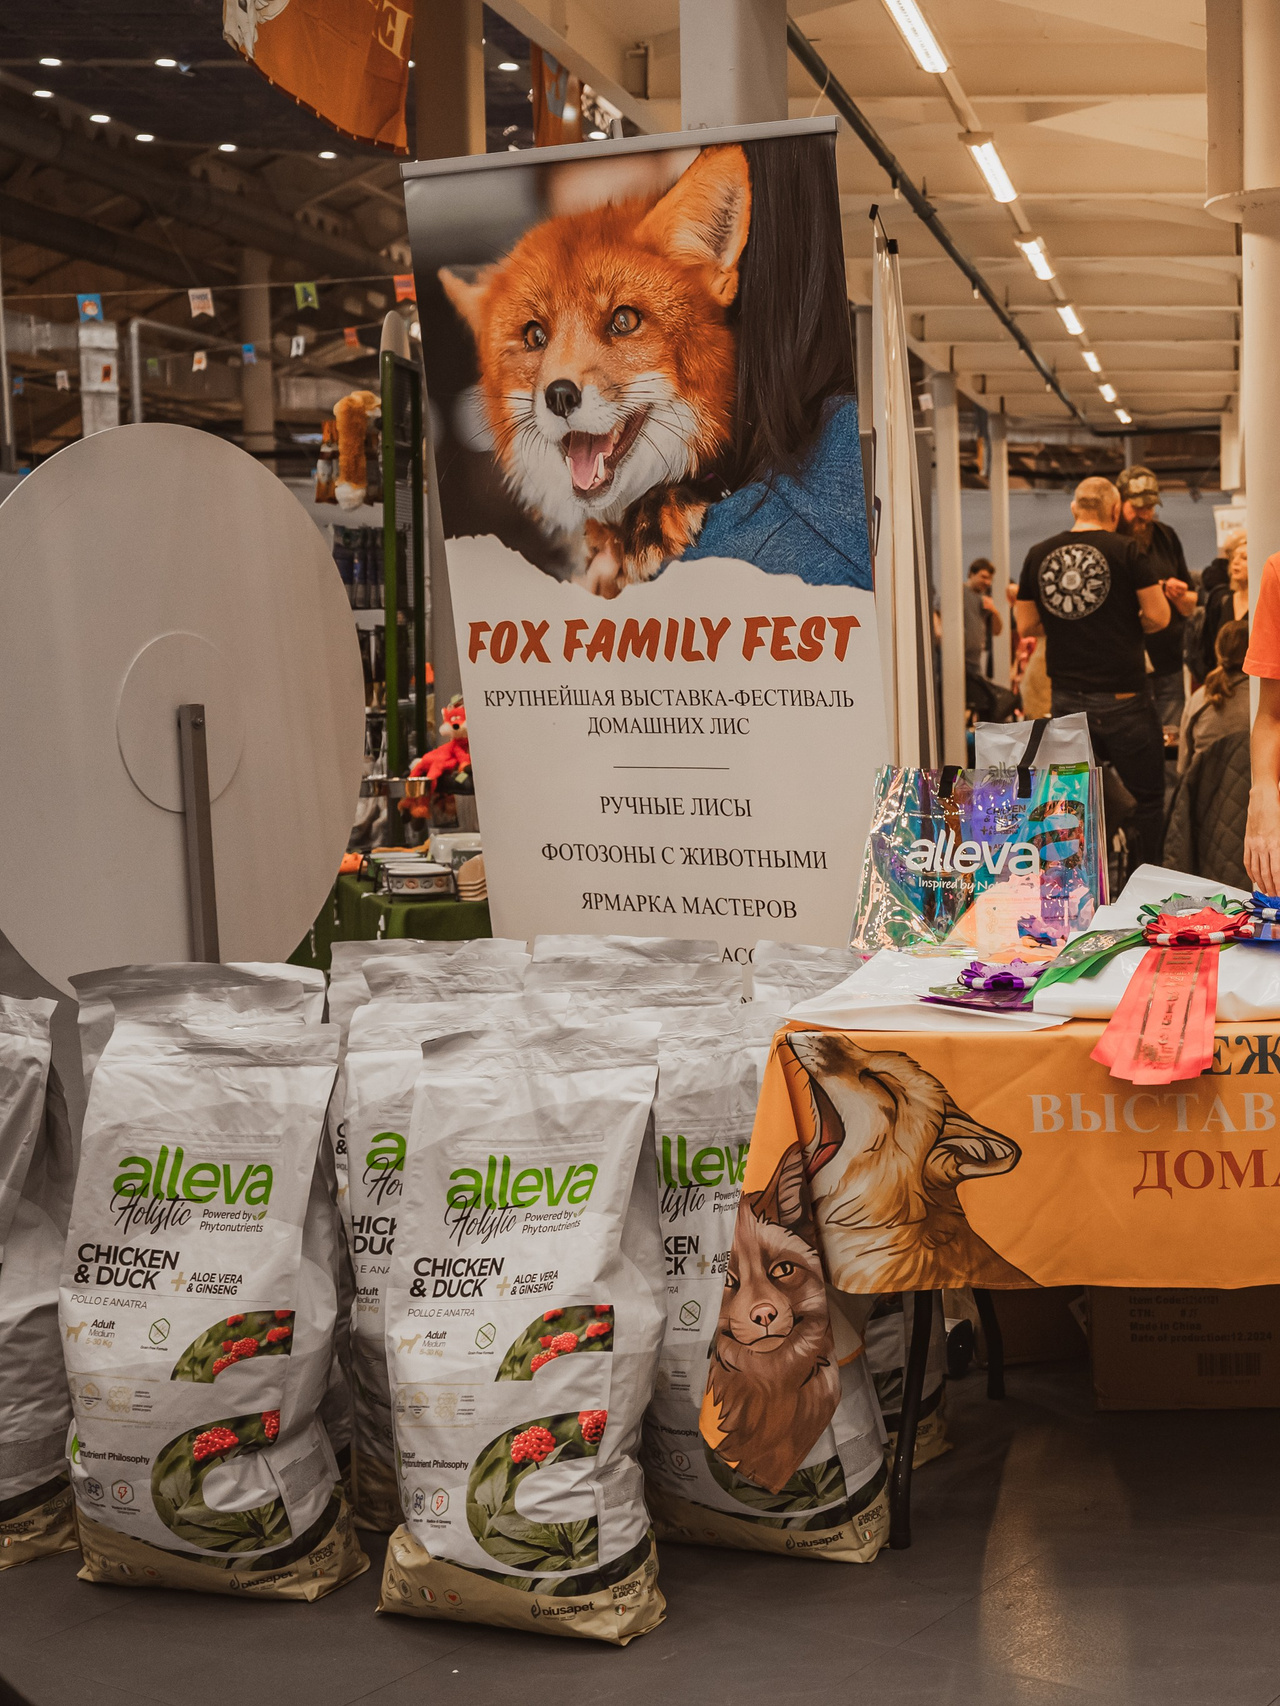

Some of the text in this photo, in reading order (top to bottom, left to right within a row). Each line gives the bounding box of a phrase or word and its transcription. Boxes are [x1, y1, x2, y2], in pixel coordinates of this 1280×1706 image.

[467, 615, 862, 665] FOX FAMILY FEST
[483, 684, 855, 708] КРУПНЕЙШАЯ ВЫСТАВКА-ФЕСТИВАЛЬ
[587, 716, 751, 737] ДОМАШНИХ ЛИС
[599, 796, 752, 818] РУЧНЫЕ ЛИСЫ
[541, 842, 829, 870] ФОТОЗОНЫ С ЖИВОТНЫМИ
[905, 829, 1040, 876] alleva
[918, 877, 958, 891] Inspired
[960, 878, 976, 891] by
[581, 892, 797, 919] ЯРМАРКА МАСТЕРОВ
[656, 1135, 750, 1188] llev
[112, 1144, 274, 1206] alleva
[445, 1154, 600, 1211] alleva
[109, 1182, 203, 1235] Holistic
[660, 1180, 713, 1223] listic
[202, 1208, 253, 1223] Powered by
[444, 1193, 526, 1247] Holistic
[523, 1210, 573, 1222] Powered by
[199, 1220, 264, 1234] Phytonutrients
[521, 1219, 582, 1235] Phytonutrients
[77, 1243, 181, 1271] CHICKEN
[413, 1256, 505, 1278] CHICKEN
[73, 1265, 161, 1291] & DUCK
[190, 1272, 244, 1285] ALOE VERA
[513, 1270, 559, 1286] ALOE VERA
[186, 1282, 238, 1296] & GINSENG
[409, 1279, 485, 1299] & DUCK
[510, 1280, 555, 1296] & GINSENG
[70, 1294, 148, 1310] POLLO E ANATRA
[357, 1296, 380, 1305] edium
[407, 1308, 475, 1318] POLLO E ANATRA
[91, 1318, 116, 1330] Adult
[1129, 1322, 1157, 1331] Made
[1172, 1321, 1202, 1331] China
[88, 1328, 116, 1339] Medium
[424, 1330, 447, 1340] Adult
[1131, 1333, 1155, 1343] Date
[85, 1338, 113, 1348] 5-30 Kg
[421, 1339, 446, 1348] Medium
[434, 1349, 444, 1358] Kg
[660, 1427, 699, 1438] Philosophy
[107, 1452, 151, 1465] Philosophy
[432, 1459, 469, 1471] Philosophy
[857, 1503, 884, 1521] CHICKEN
[864, 1512, 882, 1524] DUCK
[315, 1550, 335, 1562] DUCK
[611, 1579, 641, 1594] CHICKEN
[619, 1586, 638, 1599] DUCK
